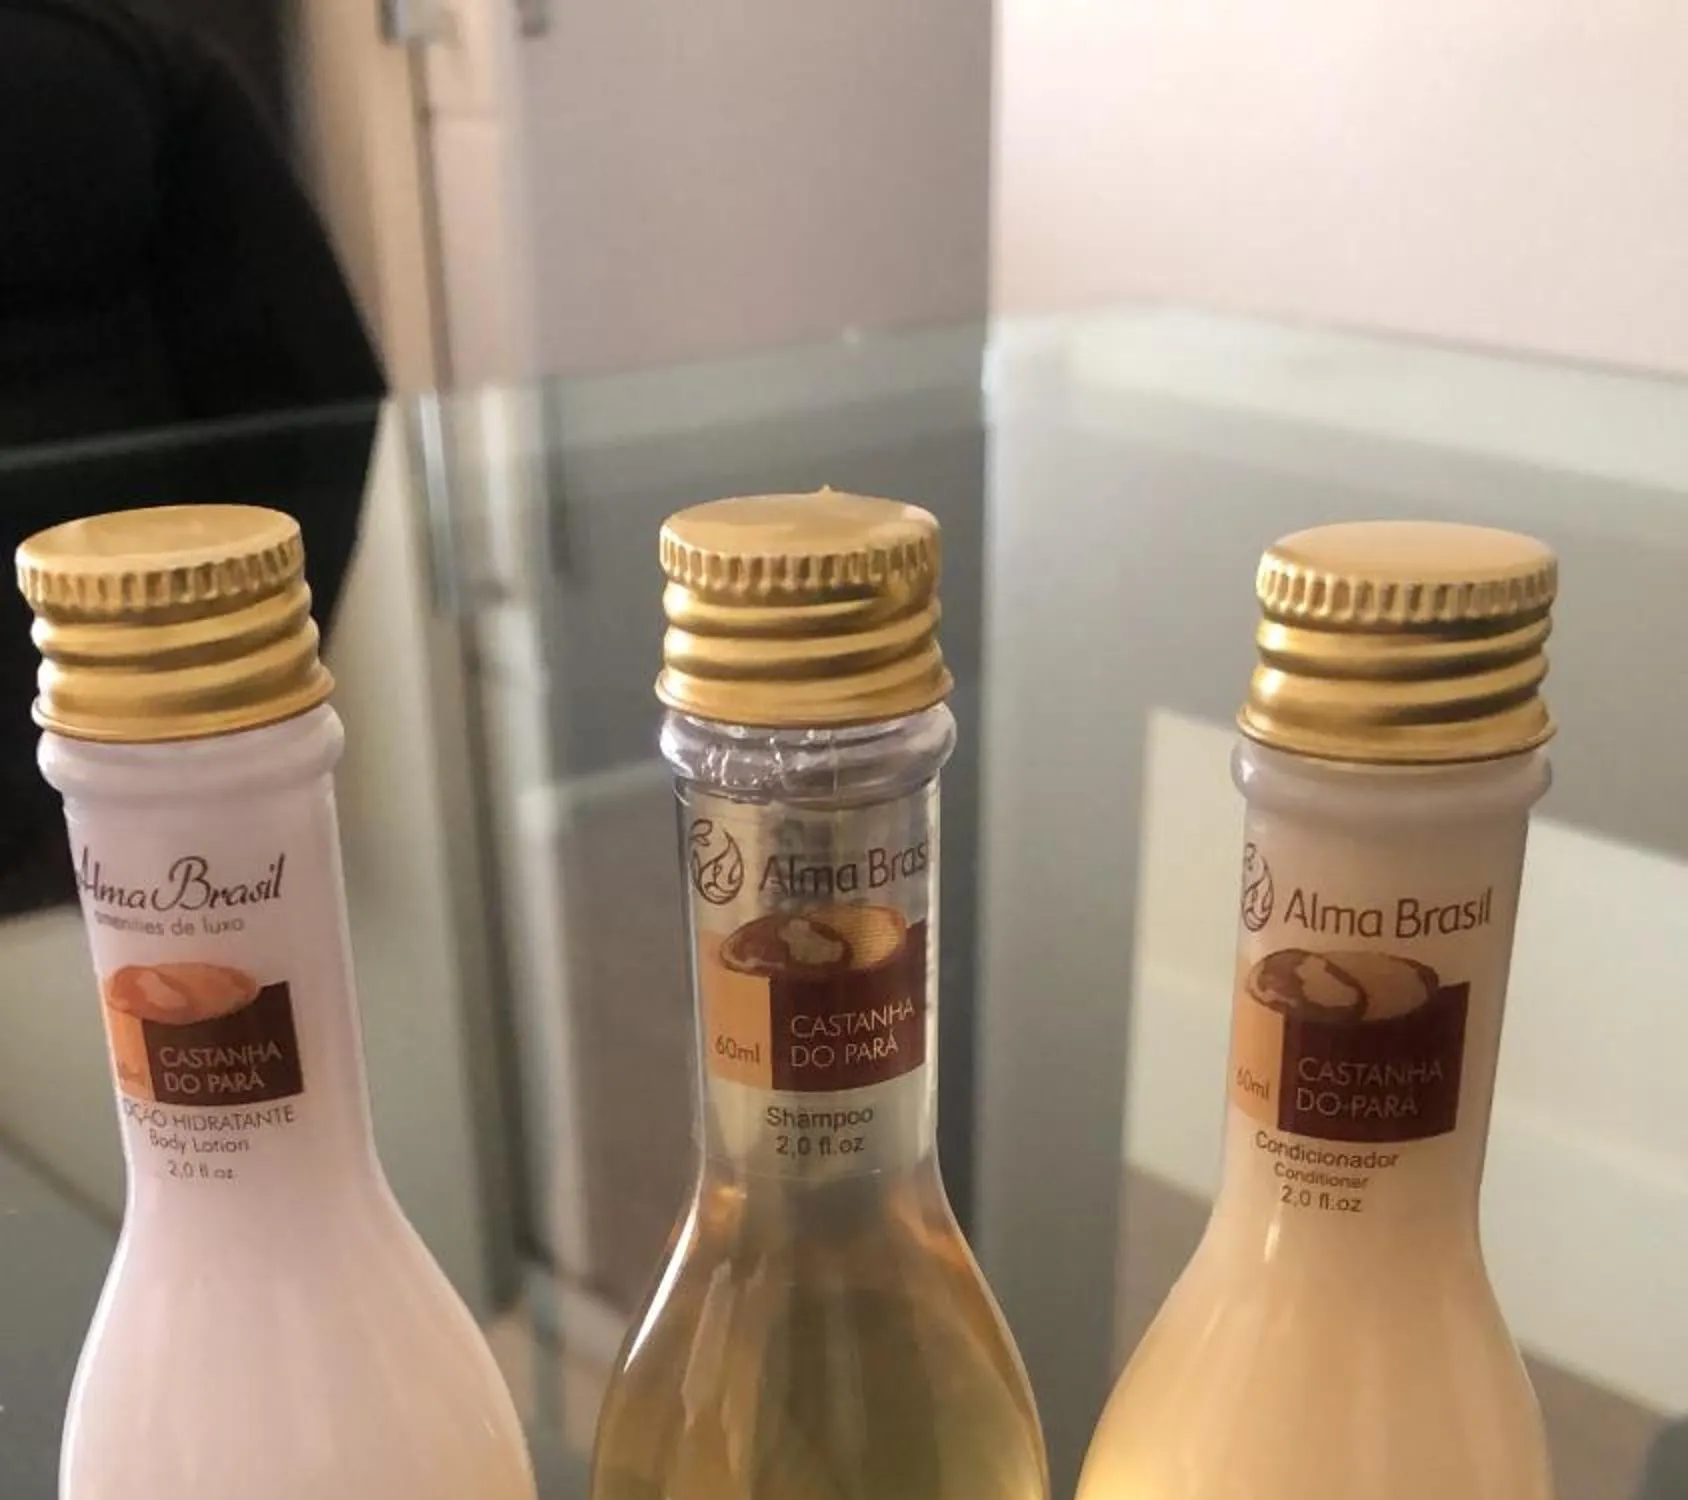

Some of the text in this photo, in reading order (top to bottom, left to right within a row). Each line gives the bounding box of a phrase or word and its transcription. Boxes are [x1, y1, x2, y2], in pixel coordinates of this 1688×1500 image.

[152, 853, 286, 911] Brasil
[759, 839, 928, 896] Alma Bras
[172, 917, 195, 936] de
[204, 917, 245, 935] luxo
[1283, 885, 1493, 939] Alma Brasil
[791, 998, 916, 1038] CASTANHA
[159, 1040, 282, 1068] CASTANHA
[715, 1034, 761, 1064] 60ml
[791, 1028, 899, 1069] DO PARÁ
[164, 1072, 199, 1094] DO
[208, 1069, 265, 1093] PARÁ
[1236, 1066, 1270, 1101] 60ml
[1299, 1057, 1444, 1087] CASTANHA
[172, 1104, 296, 1132] HIDRATANTE
[767, 1105, 874, 1132] Shampoo
[149, 1128, 250, 1155] Body Lotion
[776, 1135, 811, 1159] 2,0
[1255, 1131, 1400, 1169] Condicionador
[1274, 1162, 1370, 1189] Conditioner
